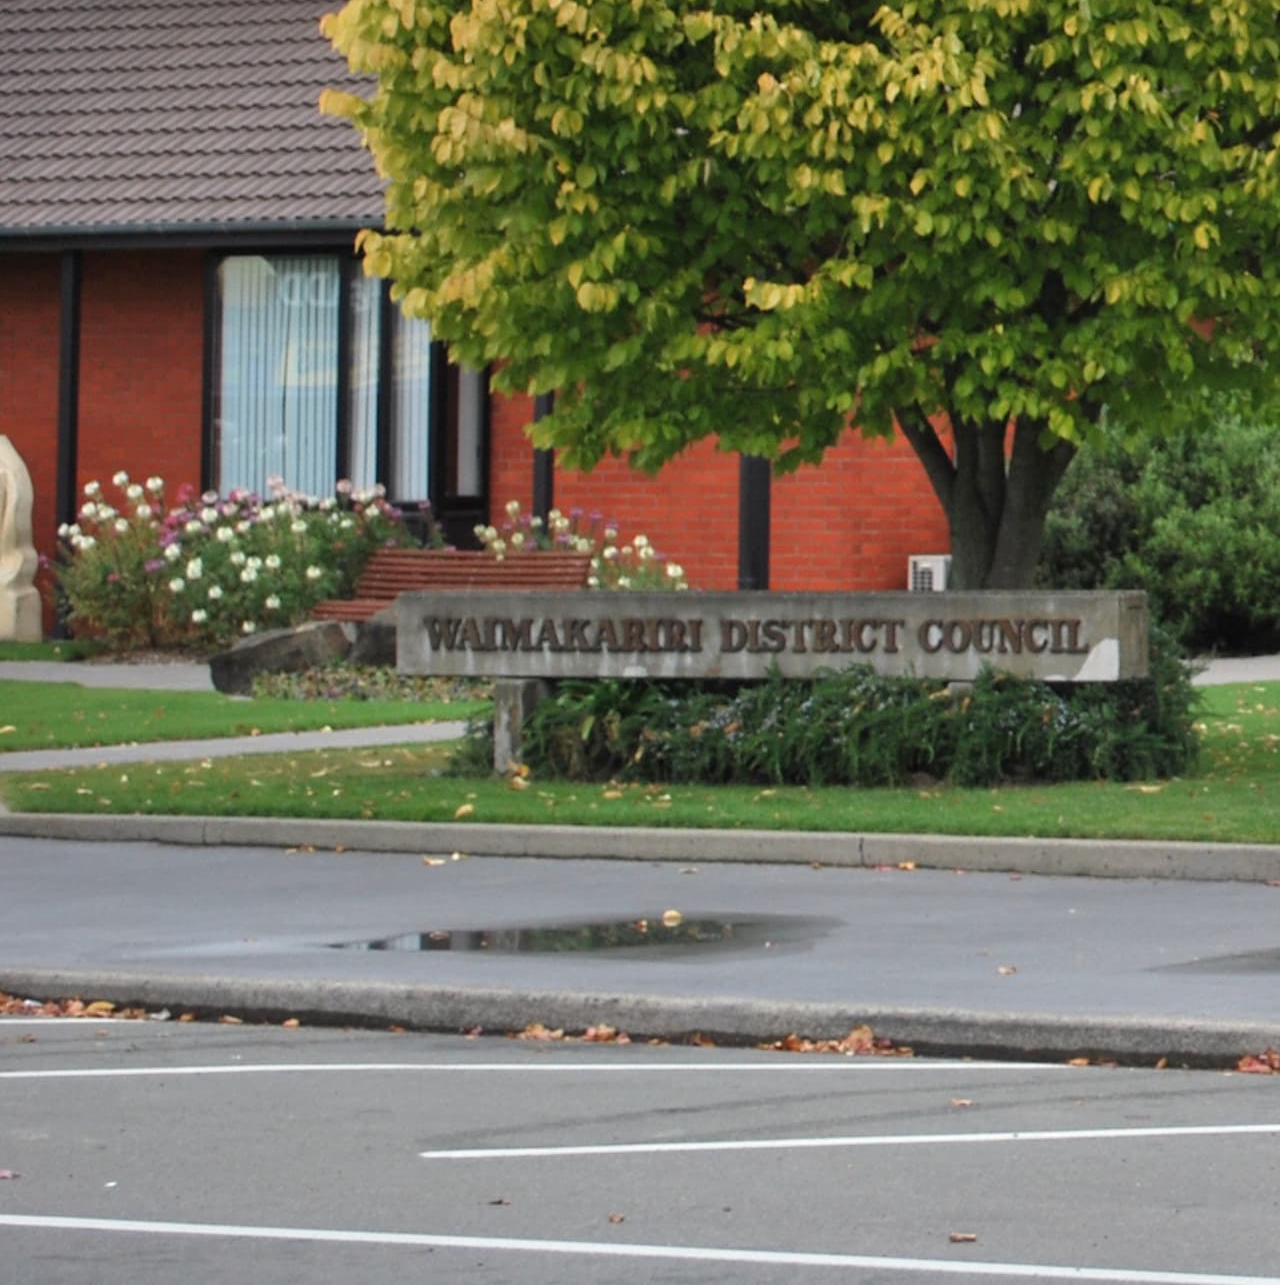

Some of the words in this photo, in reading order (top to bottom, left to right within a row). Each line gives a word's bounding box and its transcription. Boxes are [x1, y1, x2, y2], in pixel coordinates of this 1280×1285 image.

[421, 617, 703, 652] WAIMAKARIRI
[720, 618, 904, 653] DISTRICT
[917, 618, 1090, 654] COUNCIL
